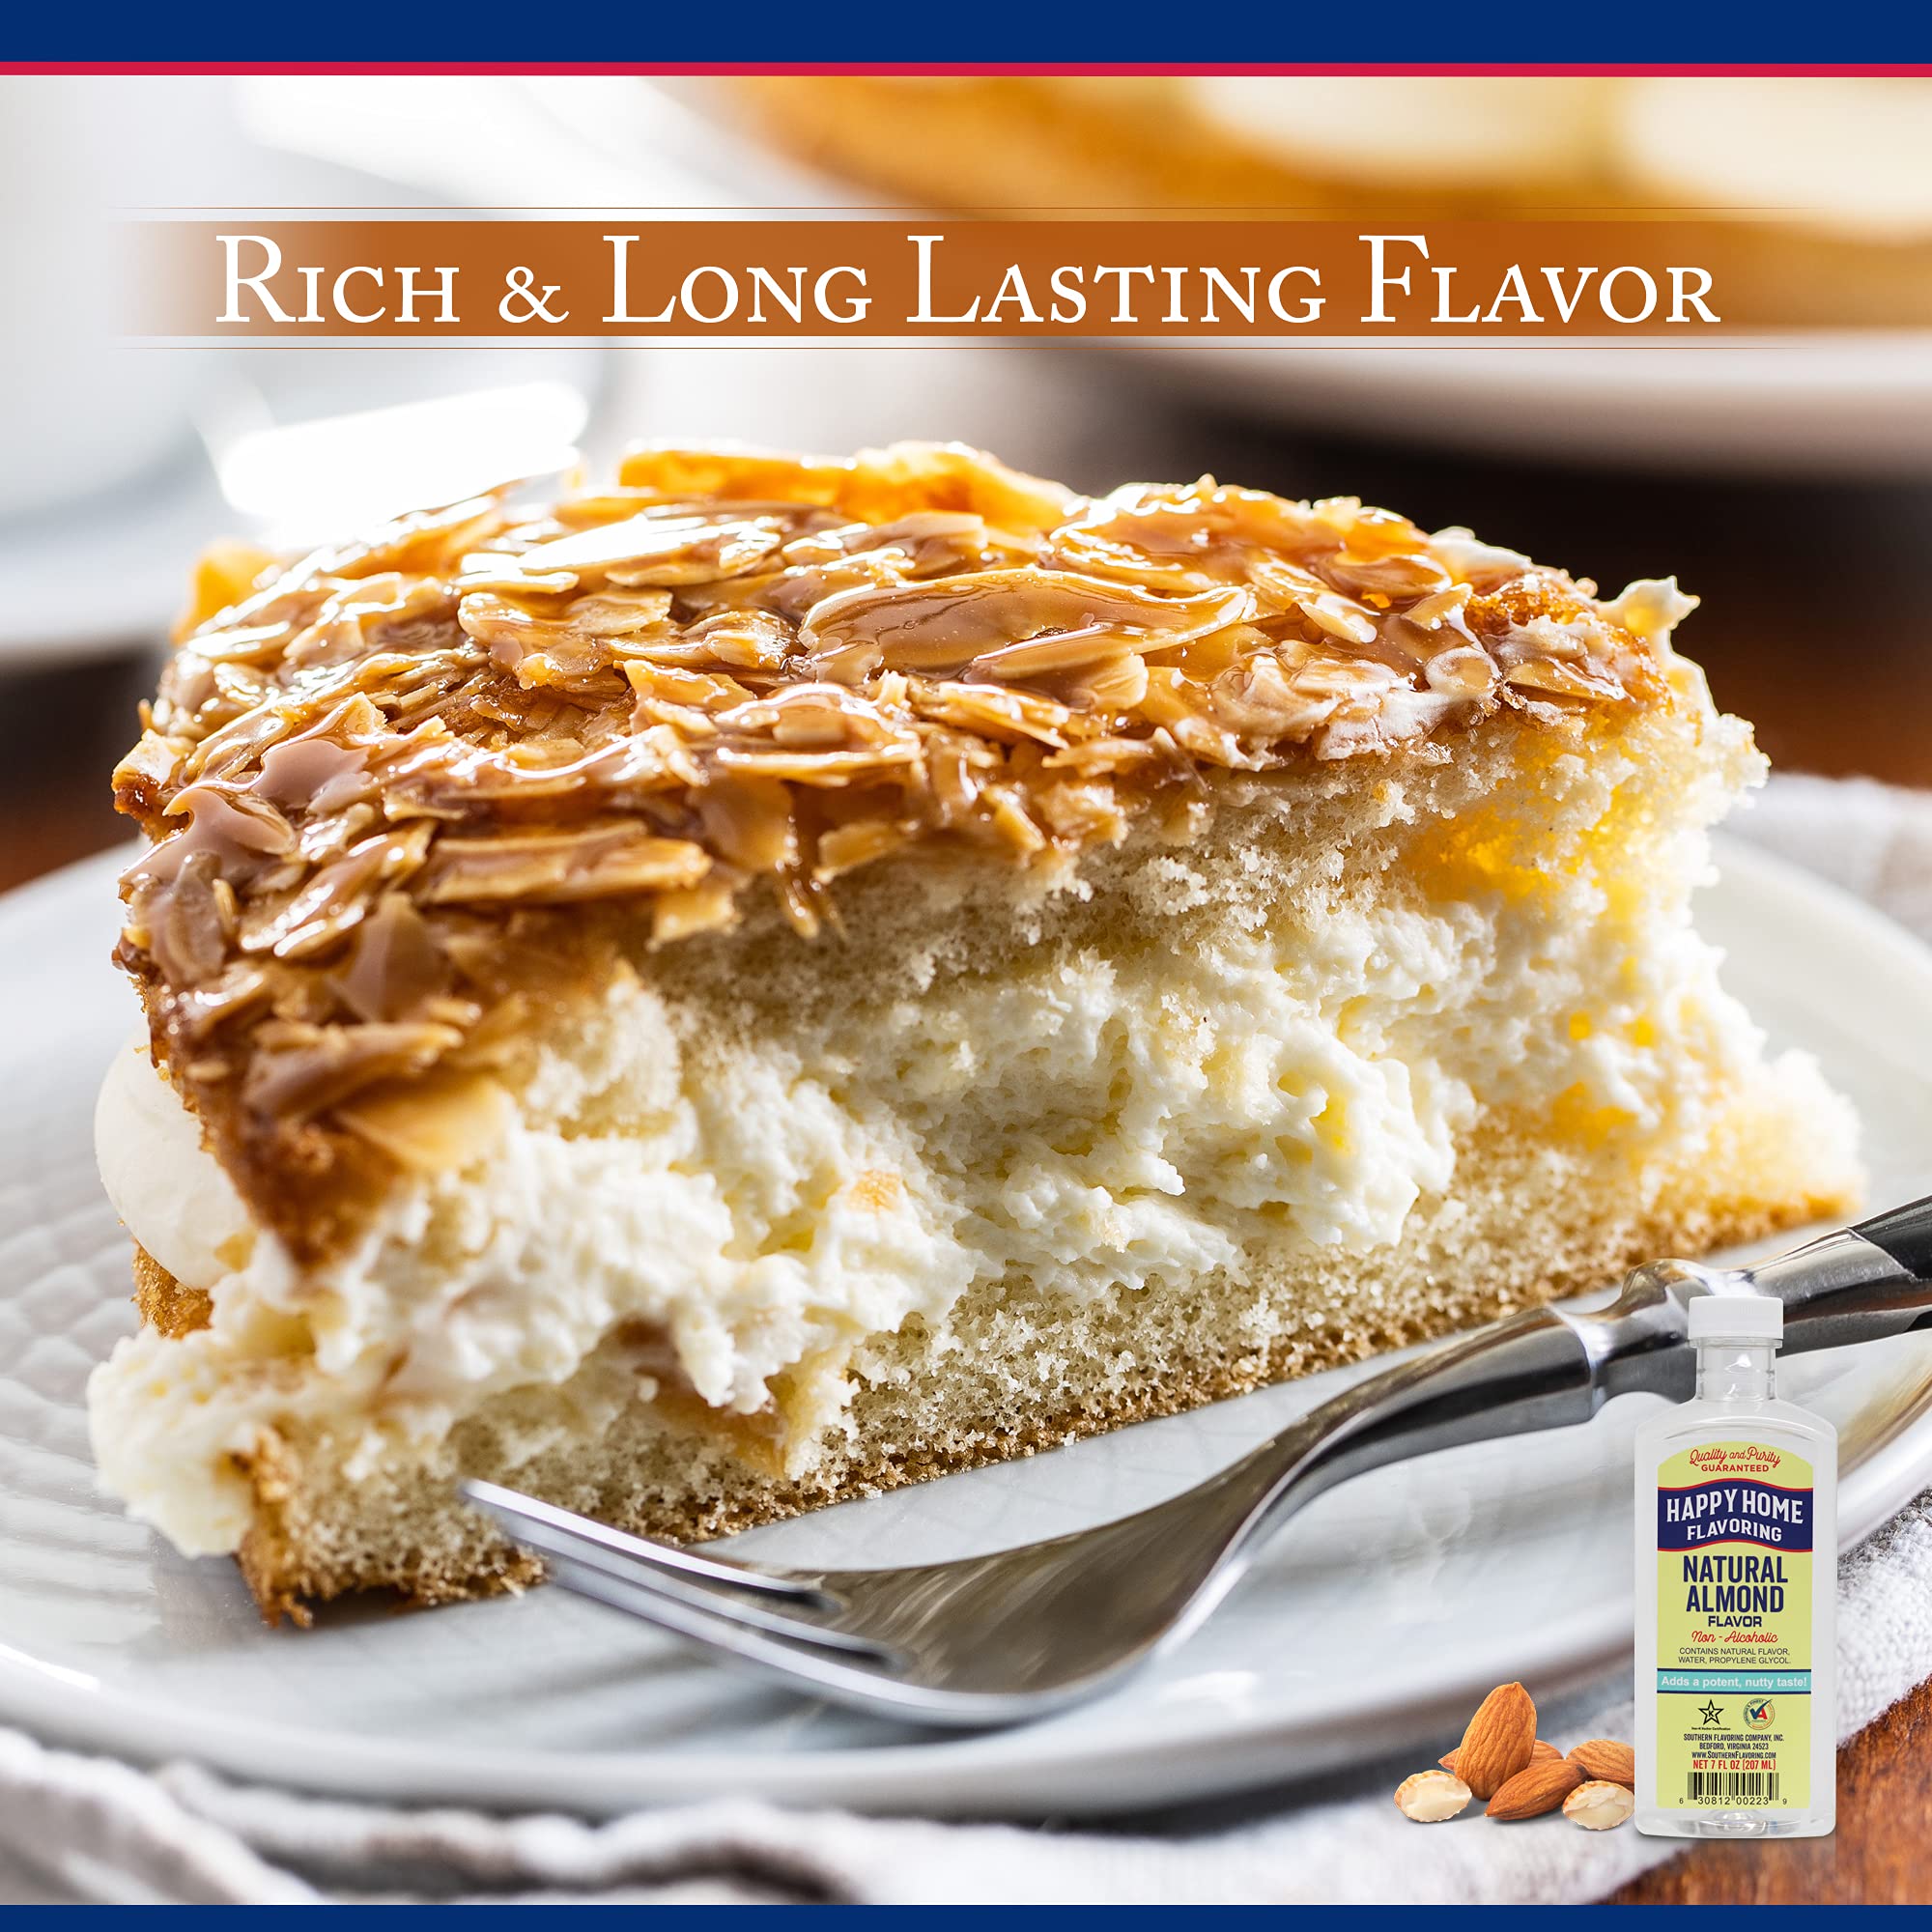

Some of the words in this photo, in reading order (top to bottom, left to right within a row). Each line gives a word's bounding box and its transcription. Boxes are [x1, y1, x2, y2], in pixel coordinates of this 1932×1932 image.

[1690, 1448, 1727, 1466] Quality
[1729, 1449, 1747, 1460] and
[1746, 1446, 1781, 1468] Purity
[1701, 1463, 1770, 1472] GUARANTEED
[1666, 1489, 1738, 1522] HAPPY
[1742, 1489, 1804, 1524] HOME
[1687, 1518, 1782, 1542] FLAVORING
[1683, 1555, 1789, 1583] NATURAL
[1686, 1585, 1784, 1613] ALMOND
[1708, 1615, 1763, 1628] FLAVOR
[1757, 1648, 1790, 1657] FLAVOR,
[1678, 1656, 1707, 1664] WATER,
[1662, 1676, 1690, 1687] Adds
[1702, 1677, 1743, 1689] potent,
[1745, 1678, 1775, 1689] nutty
[1776, 1678, 1807, 1687] taste!
[1683, 1733, 1713, 1742] SOUTHERN
[1745, 1734, 1772, 1743] COMPANY,
[1692, 1760, 1708, 1770] NET
[1711, 1760, 1716, 1770] 7
[1719, 1760, 1727, 1770] FL
[1730, 1760, 1740, 1770] OZ
[1743, 1759, 1759, 1771] (207
[1761, 1760, 1776, 1771] ML)
[1698, 1797, 1730, 1805] 30812
[1736, 1797, 1769, 1805] 00223
